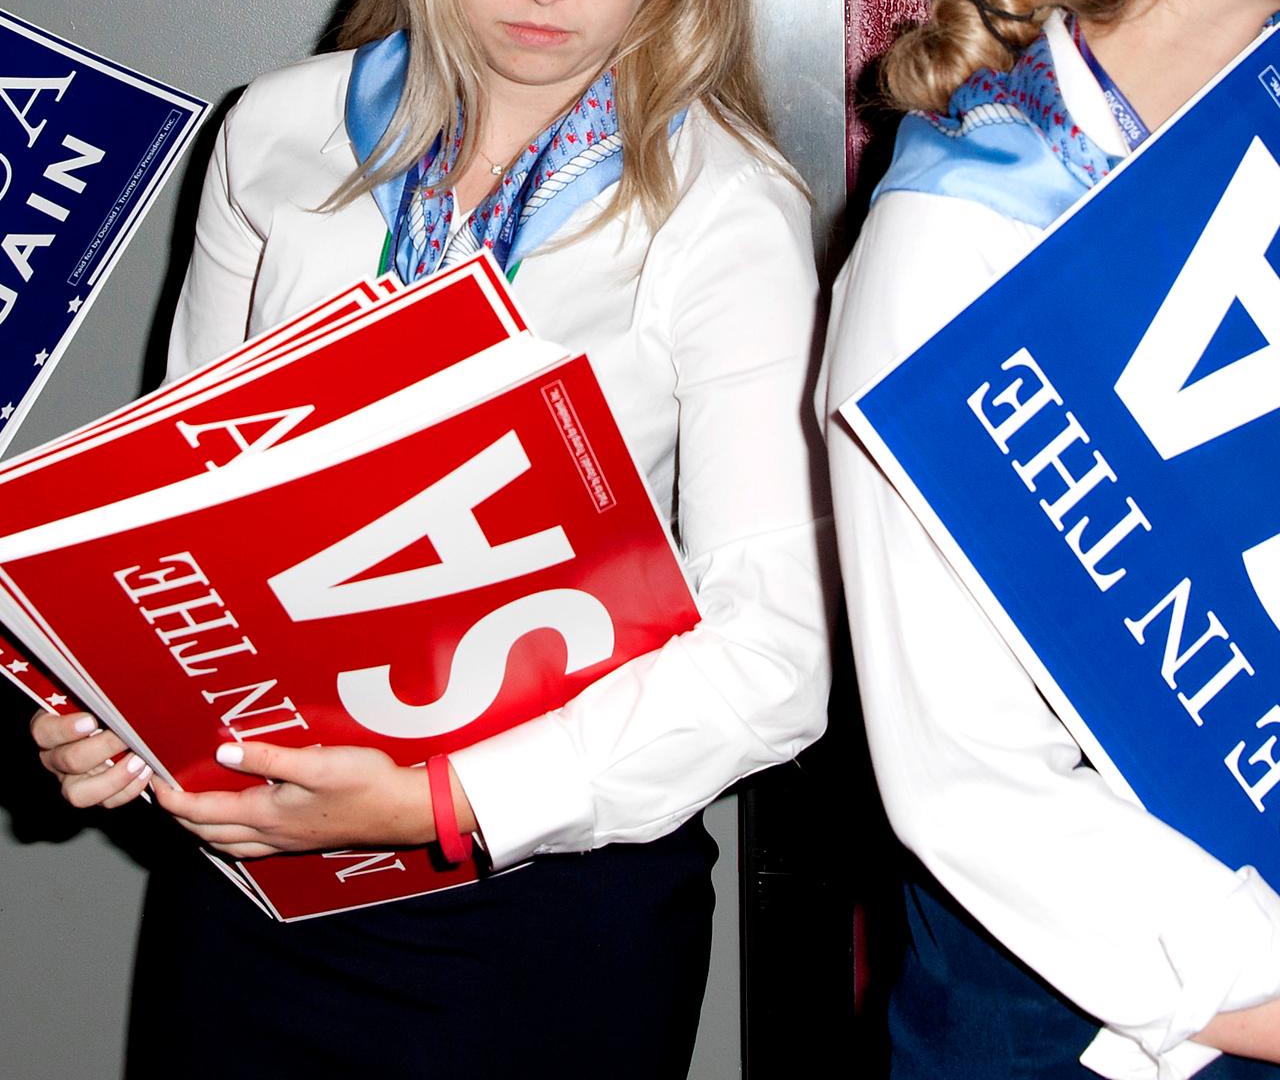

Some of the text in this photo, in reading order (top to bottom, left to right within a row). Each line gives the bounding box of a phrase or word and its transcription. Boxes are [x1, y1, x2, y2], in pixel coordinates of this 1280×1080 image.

[73, 117, 176, 278] Paid for by Donald J. Trump for President, Inc.
[967, 347, 1152, 590] THE
[113, 551, 257, 677] THE
[267, 429, 615, 767] SA
[1124, 577, 1255, 727] IN
[201, 679, 309, 744] IN
